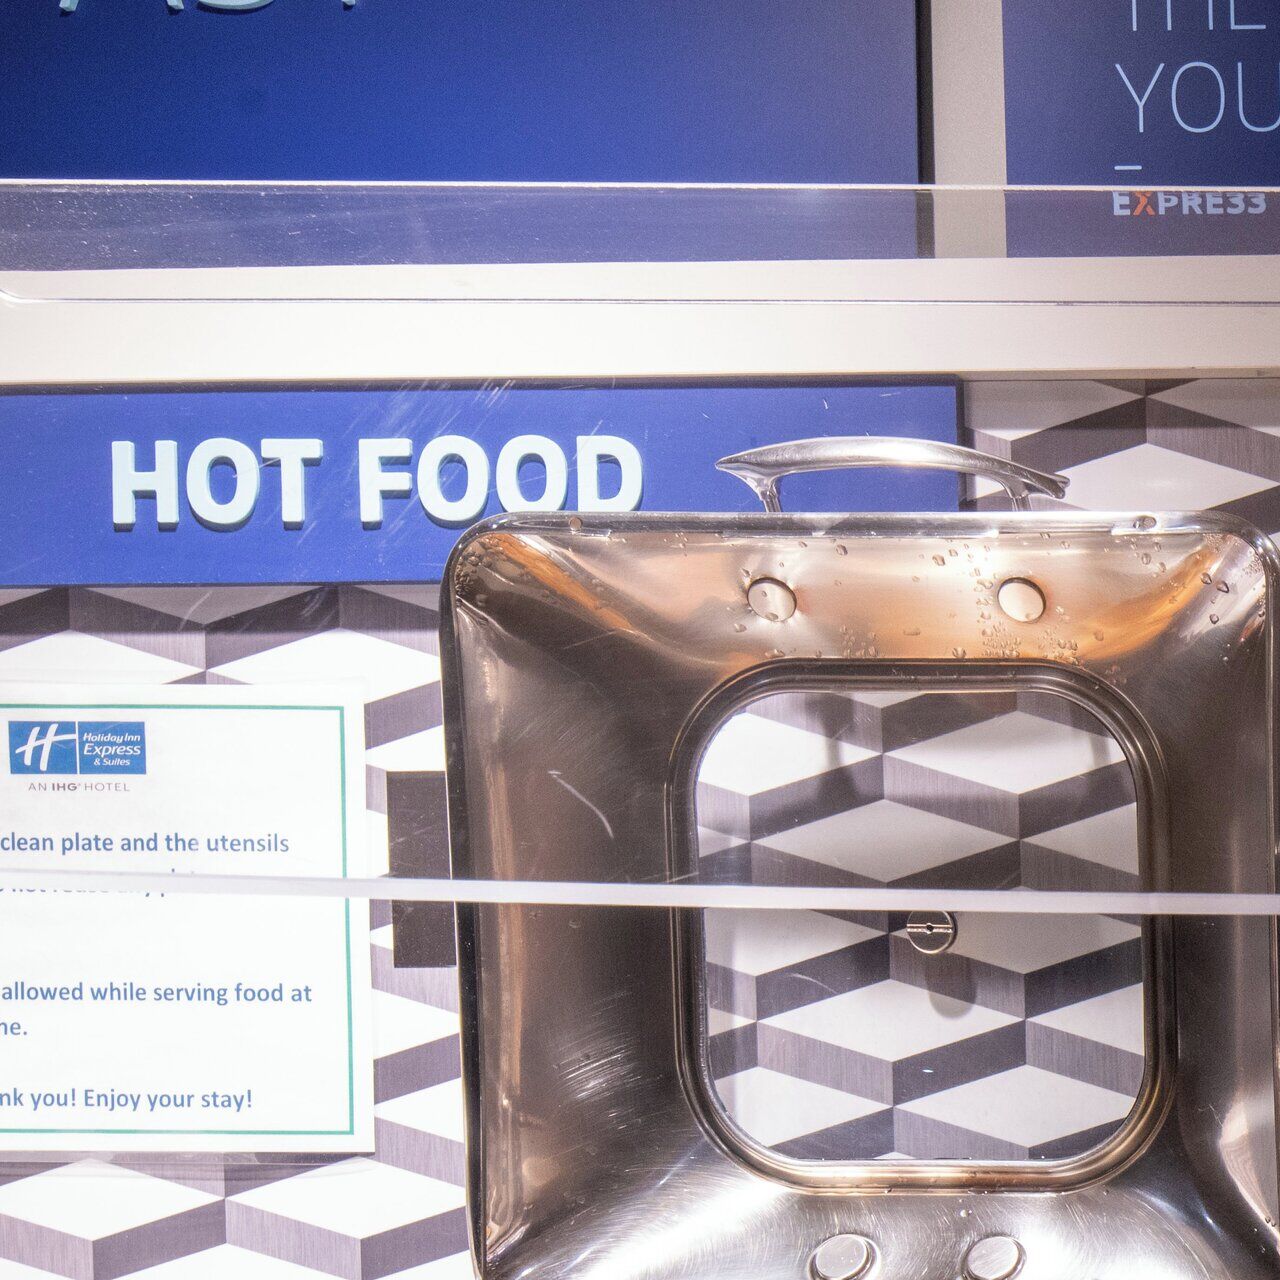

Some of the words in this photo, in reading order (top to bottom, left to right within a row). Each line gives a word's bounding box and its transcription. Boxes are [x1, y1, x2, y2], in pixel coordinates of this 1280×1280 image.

[111, 437, 323, 526] HOT
[358, 434, 643, 527] FOOD
[83, 732, 124, 743] Holiday
[124, 732, 141, 742] Inn
[83, 743, 141, 758] Express
[93, 757, 101, 766] &
[102, 757, 131, 766] Suites
[28, 782, 47, 791] AN
[84, 782, 130, 791] HOTEL
[0, 831, 54, 851] clean
[61, 832, 114, 855] plate
[120, 832, 158, 851] and
[164, 832, 199, 851] the
[206, 833, 290, 852] utensils
[1, 982, 83, 1001] allowed
[90, 982, 147, 1001] while
[153, 982, 228, 1006] serving
[234, 983, 283, 1002] food
[290, 984, 312, 1002] at
[30, 1088, 76, 1111] you!
[84, 1088, 141, 1111] Enjoy
[147, 1092, 195, 1112] your
[201, 1089, 253, 1112] stay!
